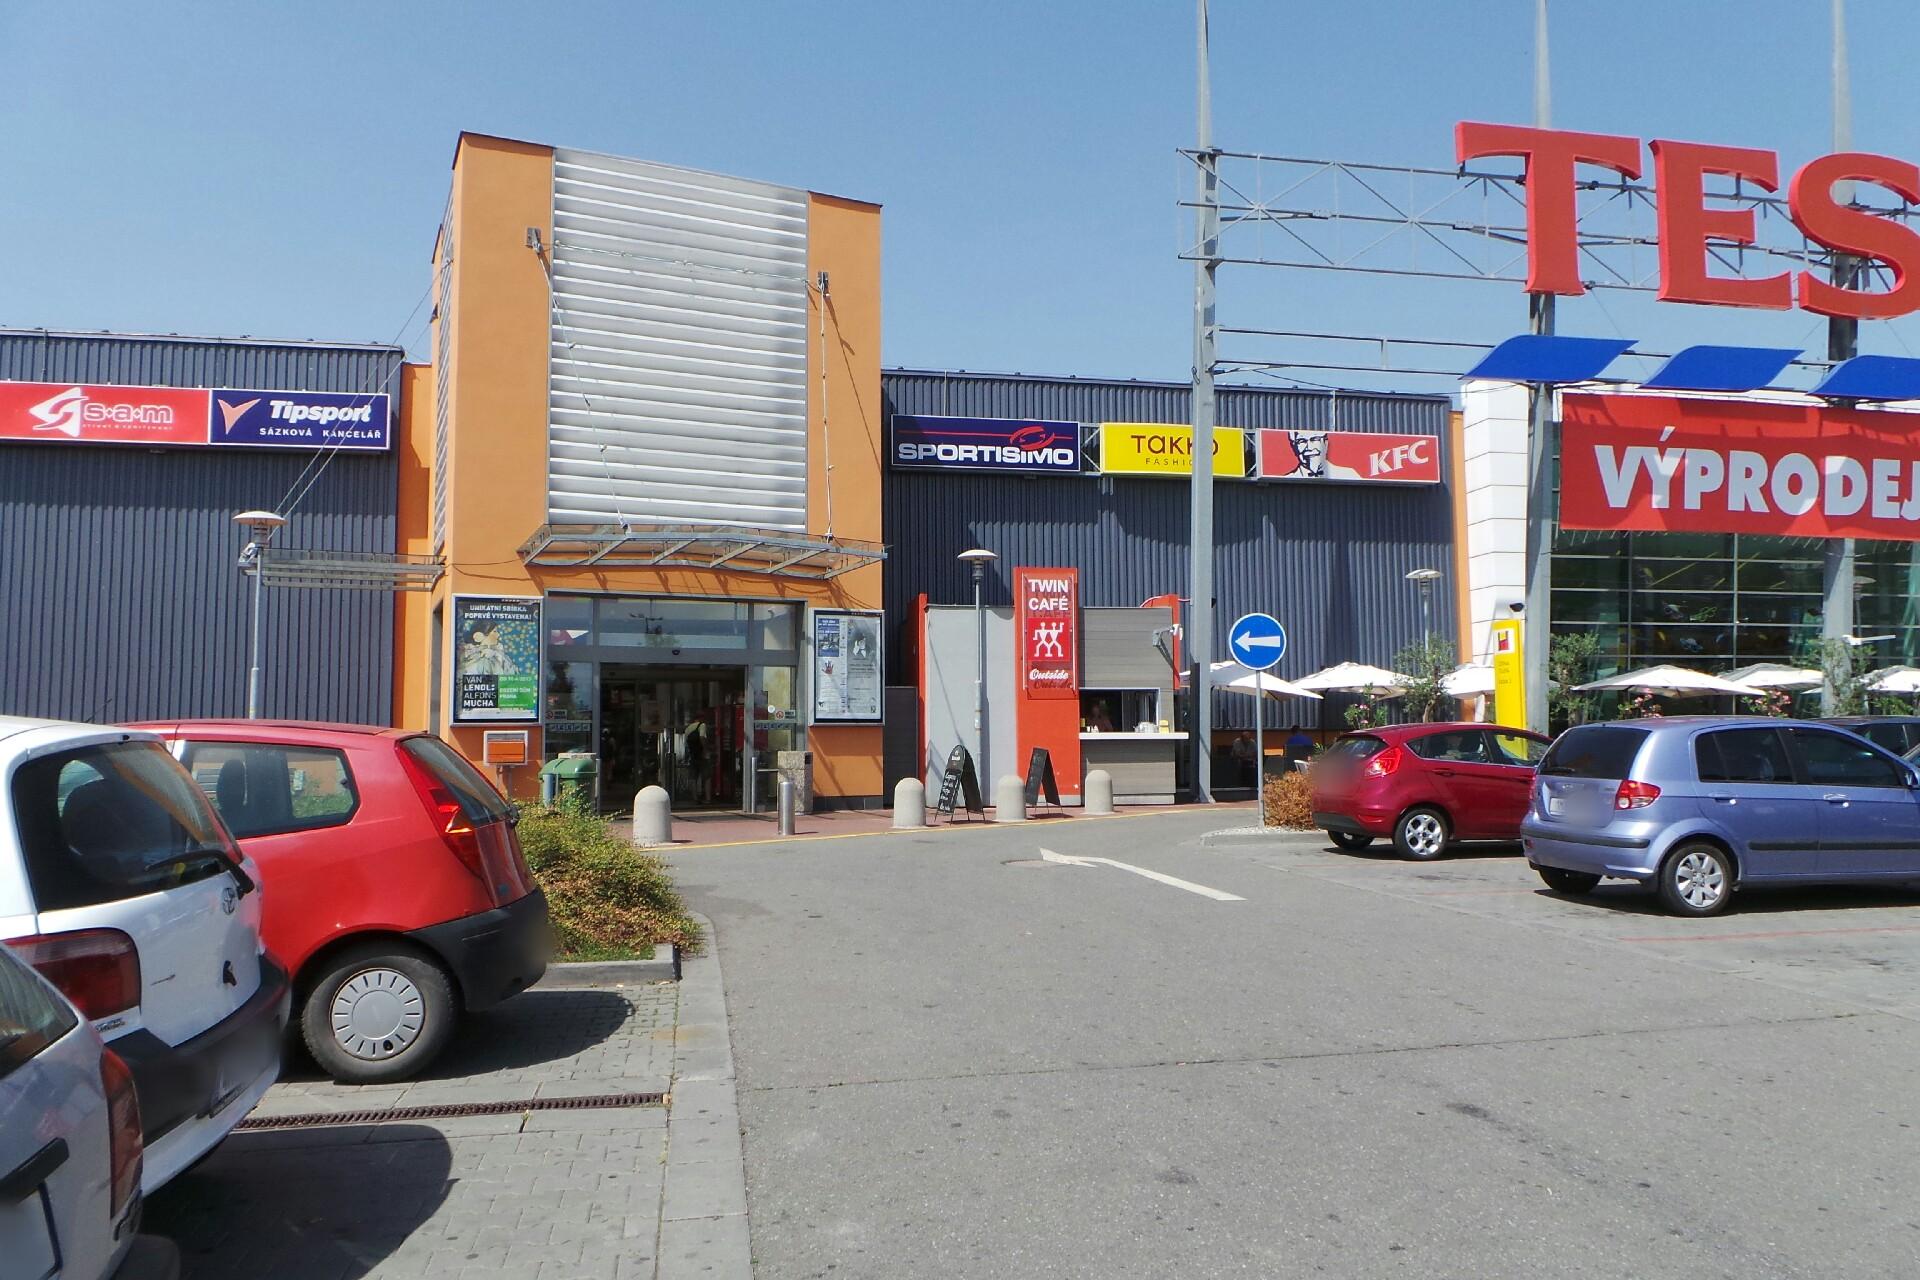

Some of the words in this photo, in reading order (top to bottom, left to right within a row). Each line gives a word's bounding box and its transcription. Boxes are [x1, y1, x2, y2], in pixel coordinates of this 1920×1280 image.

[1454, 120, 1920, 320] TES
[269, 400, 372, 425] Tipsport
[259, 427, 313, 437] SÁZKOVÁ
[322, 429, 382, 439] KANCELÁŘ
[898, 442, 1074, 466] SPORTISIMO
[1369, 439, 1429, 477] KFC
[1027, 579, 1069, 593] TWIN
[1028, 595, 1069, 611] CAFÉ
[464, 611, 491, 620] POPRVÉ
[1029, 668, 1069, 681] Outside
[464, 691, 497, 700] ALFONS
[463, 699, 494, 708] MUCHA
